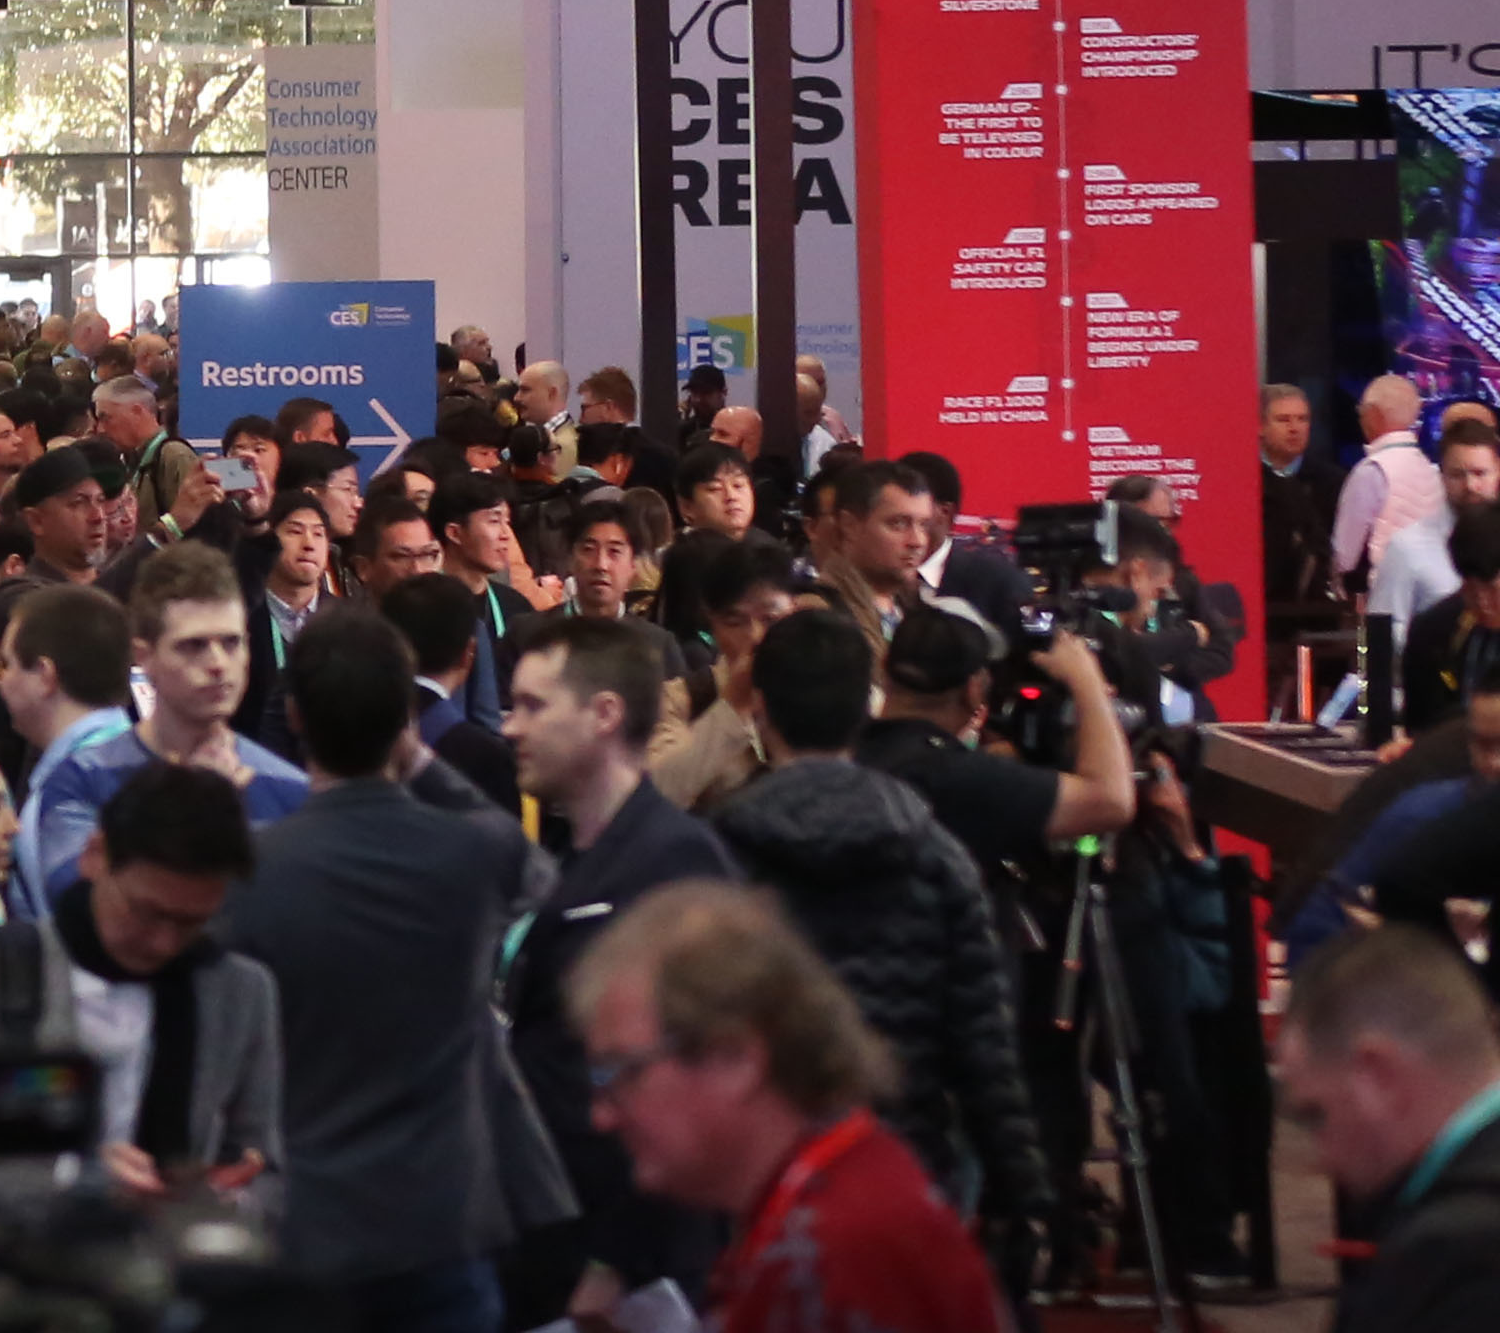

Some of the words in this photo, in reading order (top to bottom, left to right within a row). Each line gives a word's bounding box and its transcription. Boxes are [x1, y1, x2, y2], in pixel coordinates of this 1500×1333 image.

[267, 78, 362, 99] Consumer
[267, 103, 378, 131] Technology
[268, 134, 377, 157] Association
[268, 166, 349, 191] CENTER
[329, 311, 360, 326] CES
[202, 361, 364, 388] Restrooms
